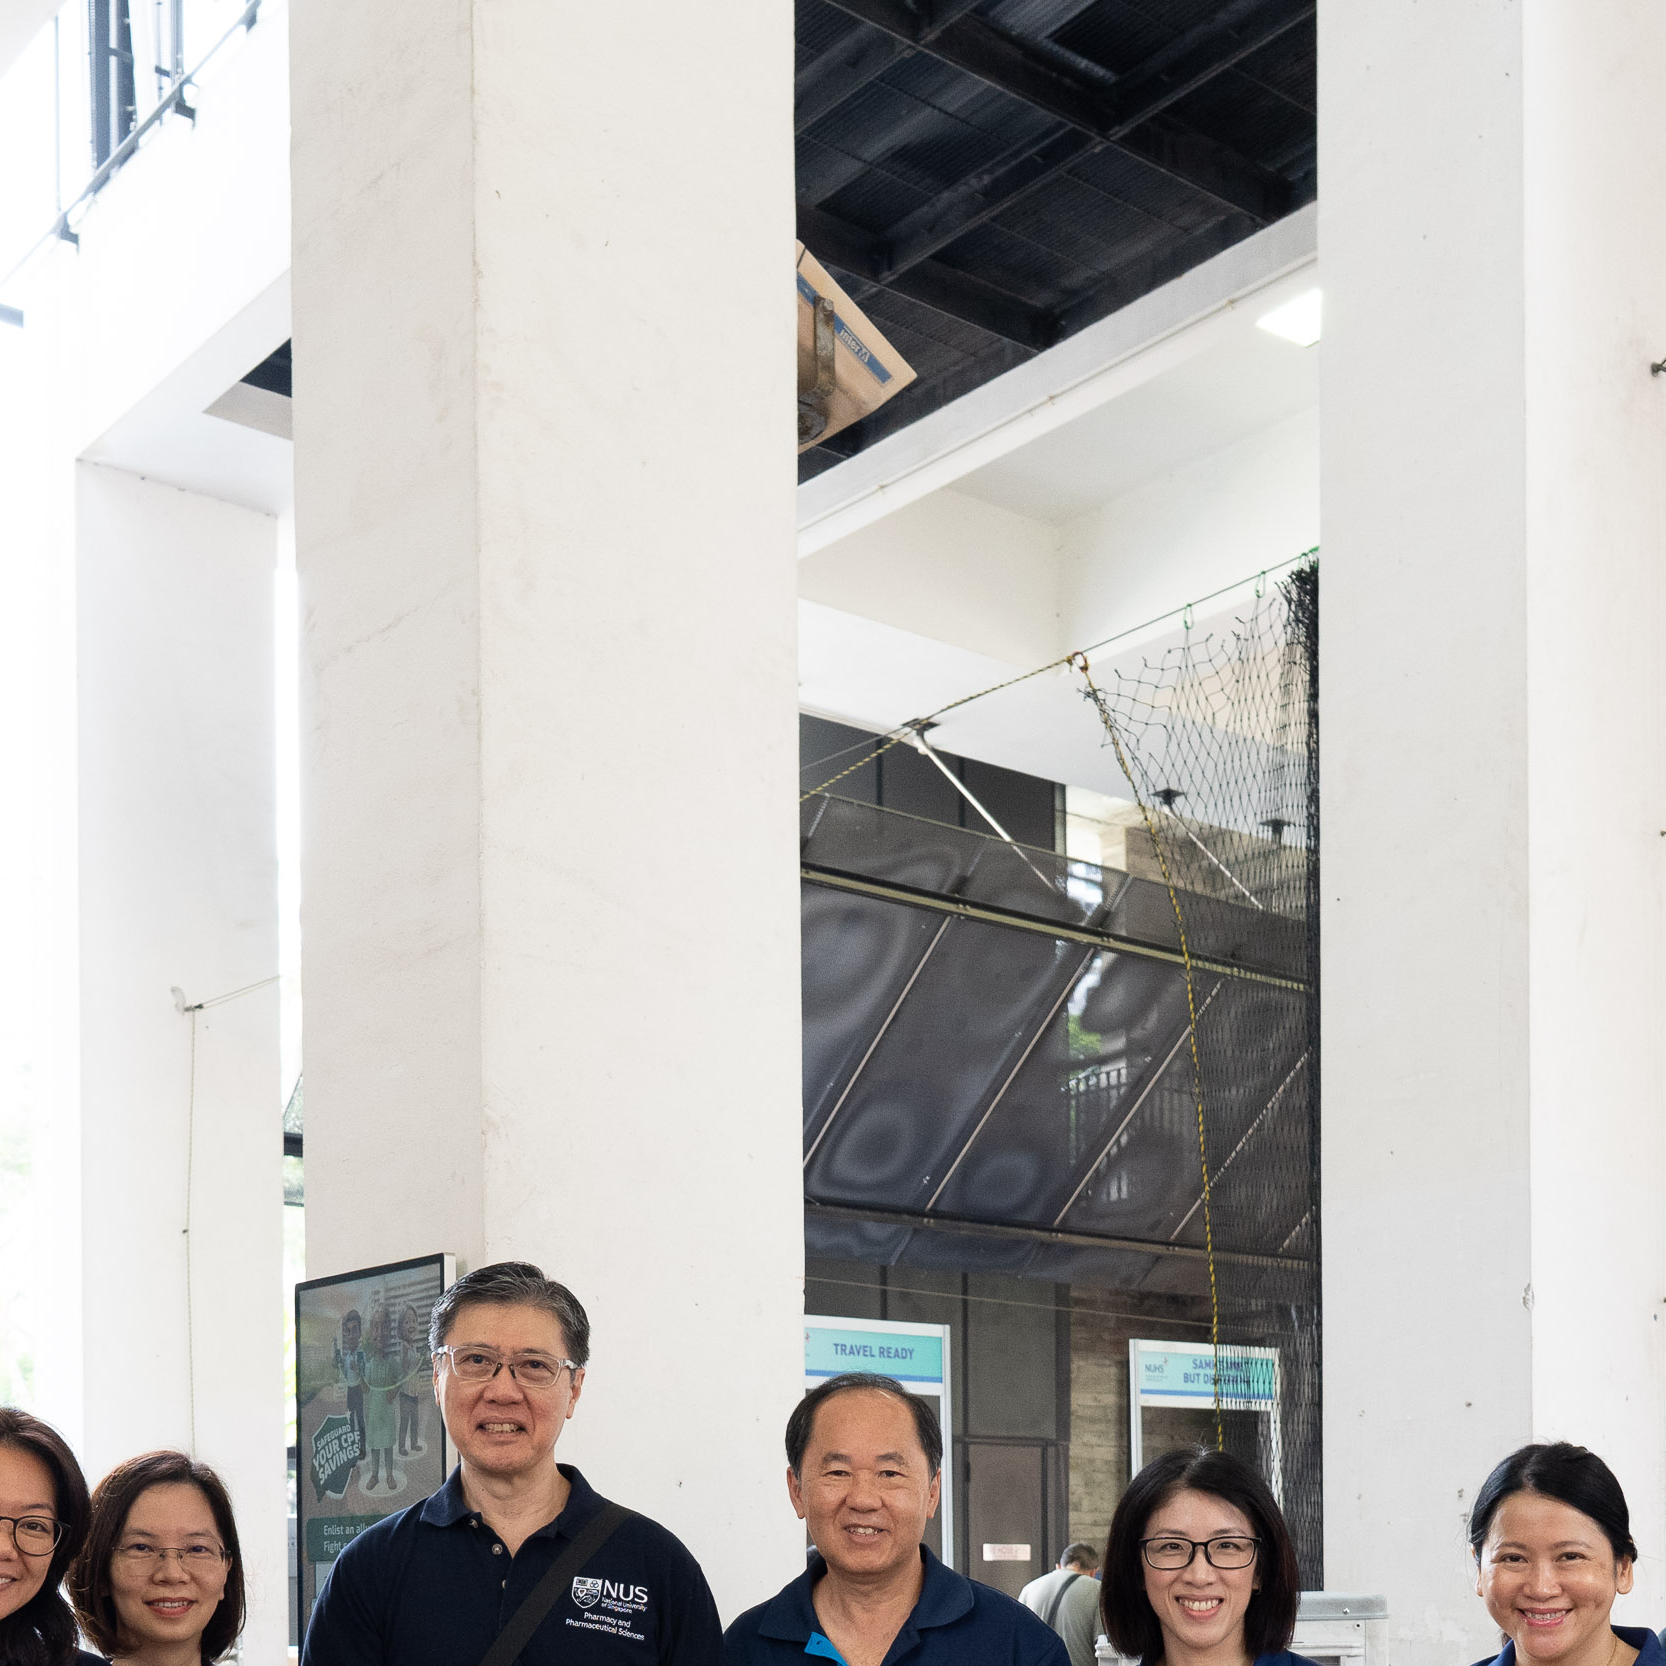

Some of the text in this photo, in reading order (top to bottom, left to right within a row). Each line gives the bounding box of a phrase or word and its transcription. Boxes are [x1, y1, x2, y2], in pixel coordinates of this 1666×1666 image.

[833, 1343, 914, 1360] TRAVEL READY
[1144, 1364, 1164, 1374] NUHS
[1183, 1373, 1200, 1384] BUT
[316, 1424, 351, 1450] SAFEGUARD
[312, 1431, 361, 1472] YOUR CPF
[323, 1524, 355, 1536] Enlist an
[323, 1541, 342, 1553] Fight
[603, 1579, 648, 1603] NUS
[601, 1597, 622, 1606] National
[584, 1612, 631, 1628] Pharmacy and
[565, 1618, 644, 1640] Pharmaceutical Sciences
